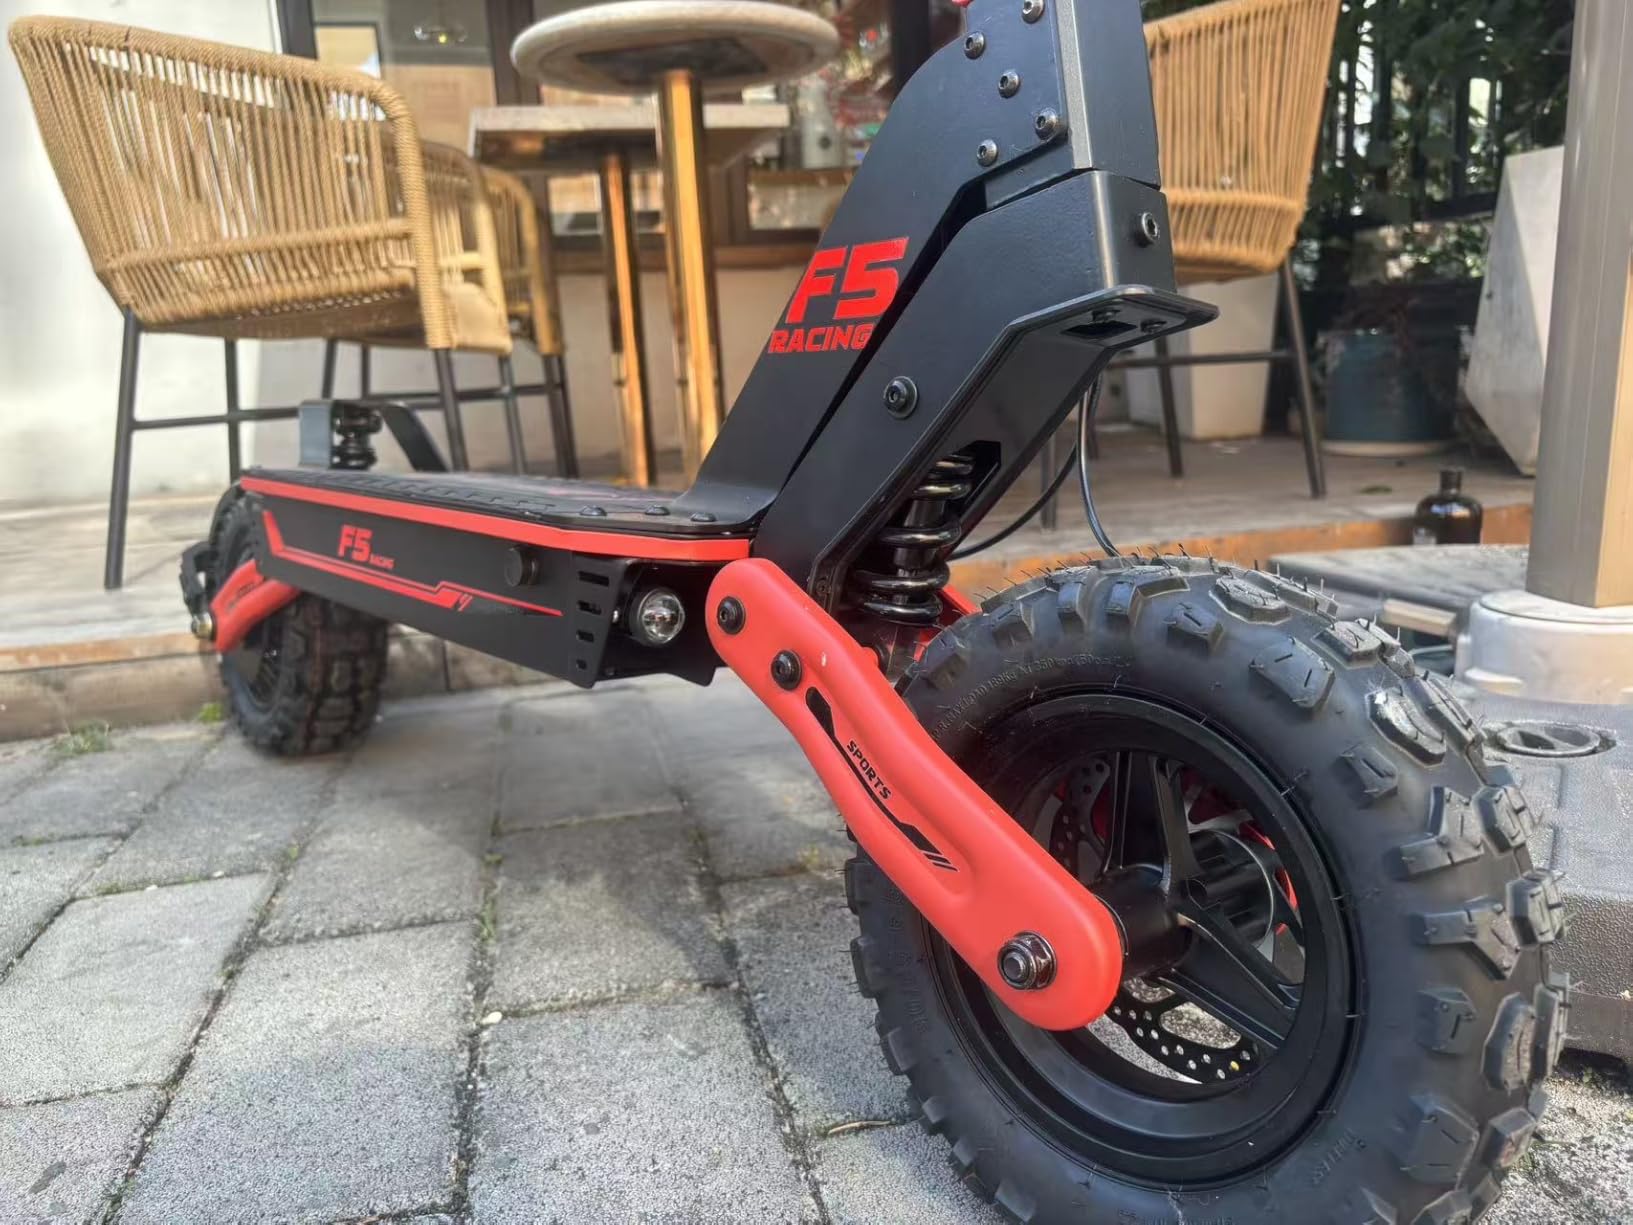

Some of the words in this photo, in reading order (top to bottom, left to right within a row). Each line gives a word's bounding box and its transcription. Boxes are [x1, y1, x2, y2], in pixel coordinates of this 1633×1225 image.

[786, 237, 910, 324] F5
[768, 323, 874, 354] RACING
[338, 524, 372, 562] F5
[847, 740, 891, 799] SPORTS
